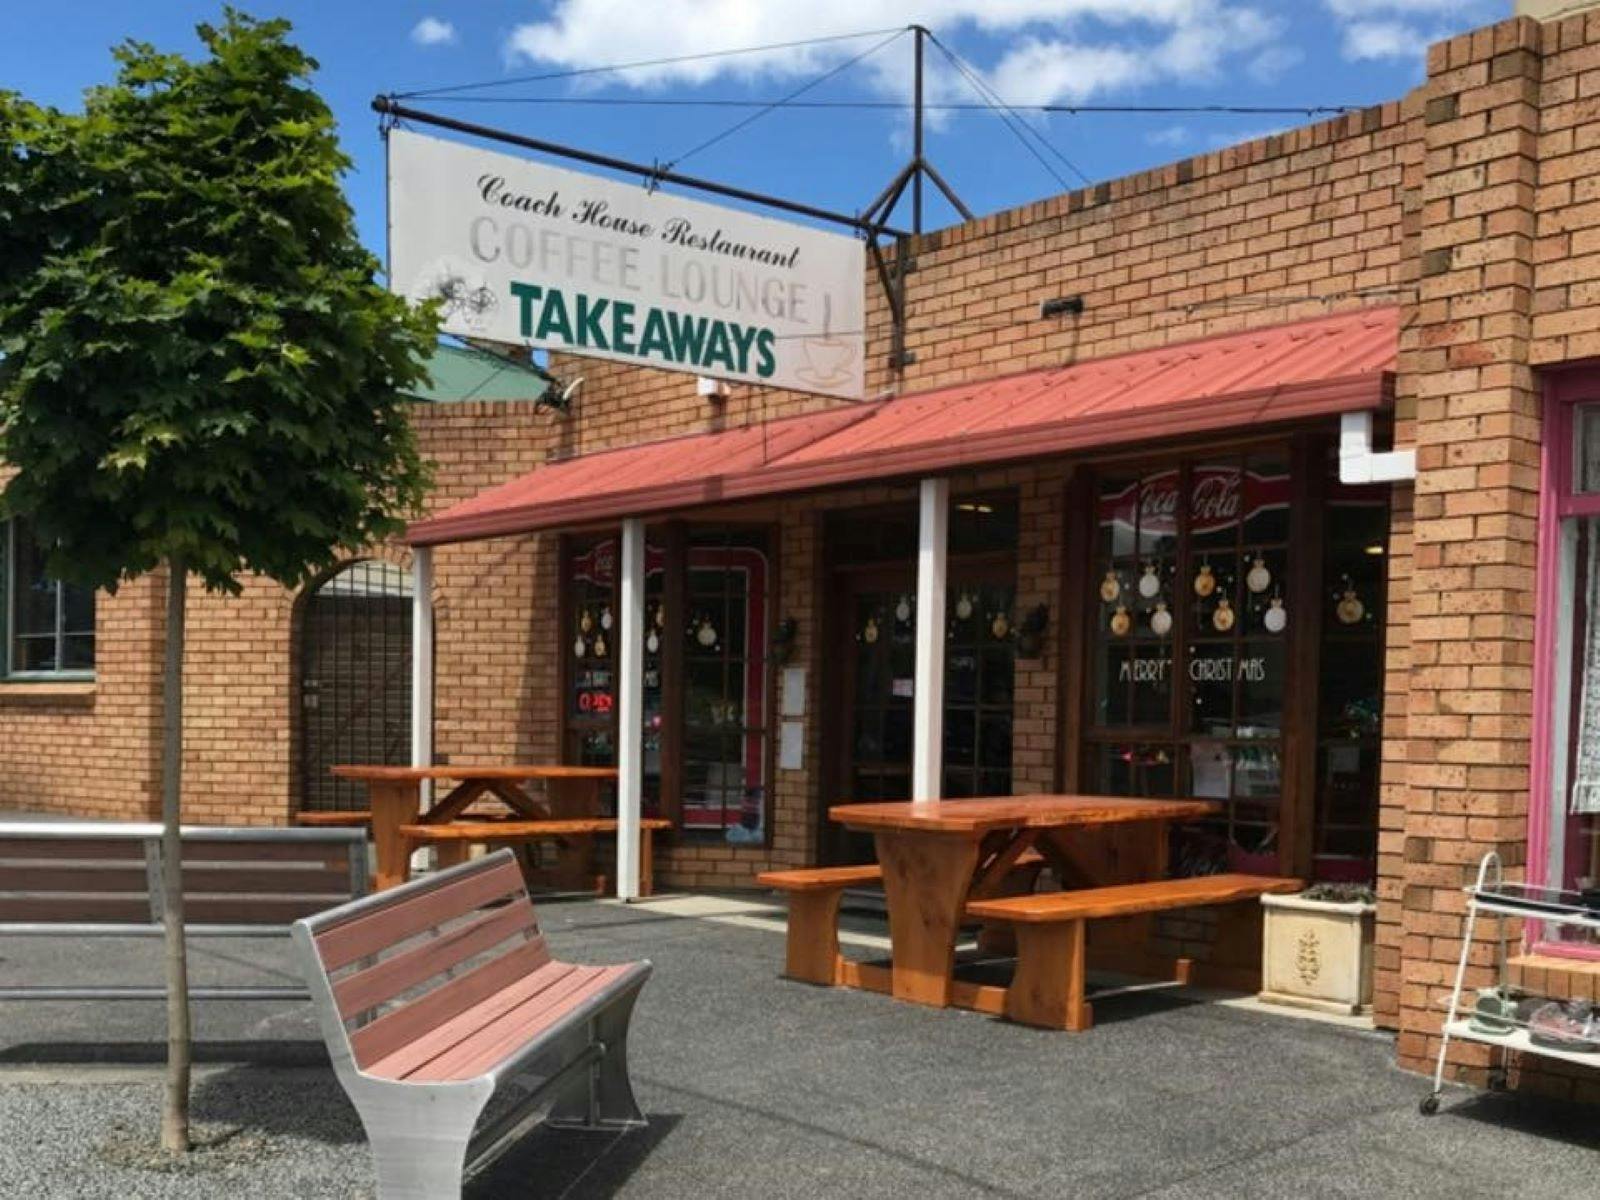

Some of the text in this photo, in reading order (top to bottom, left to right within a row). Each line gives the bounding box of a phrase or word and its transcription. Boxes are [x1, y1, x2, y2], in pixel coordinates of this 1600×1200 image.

[470, 216, 809, 323] COFFEE LOUNGE
[477, 173, 800, 269] Coach House Restaurant
[510, 281, 775, 378] TAKEAWAYS
